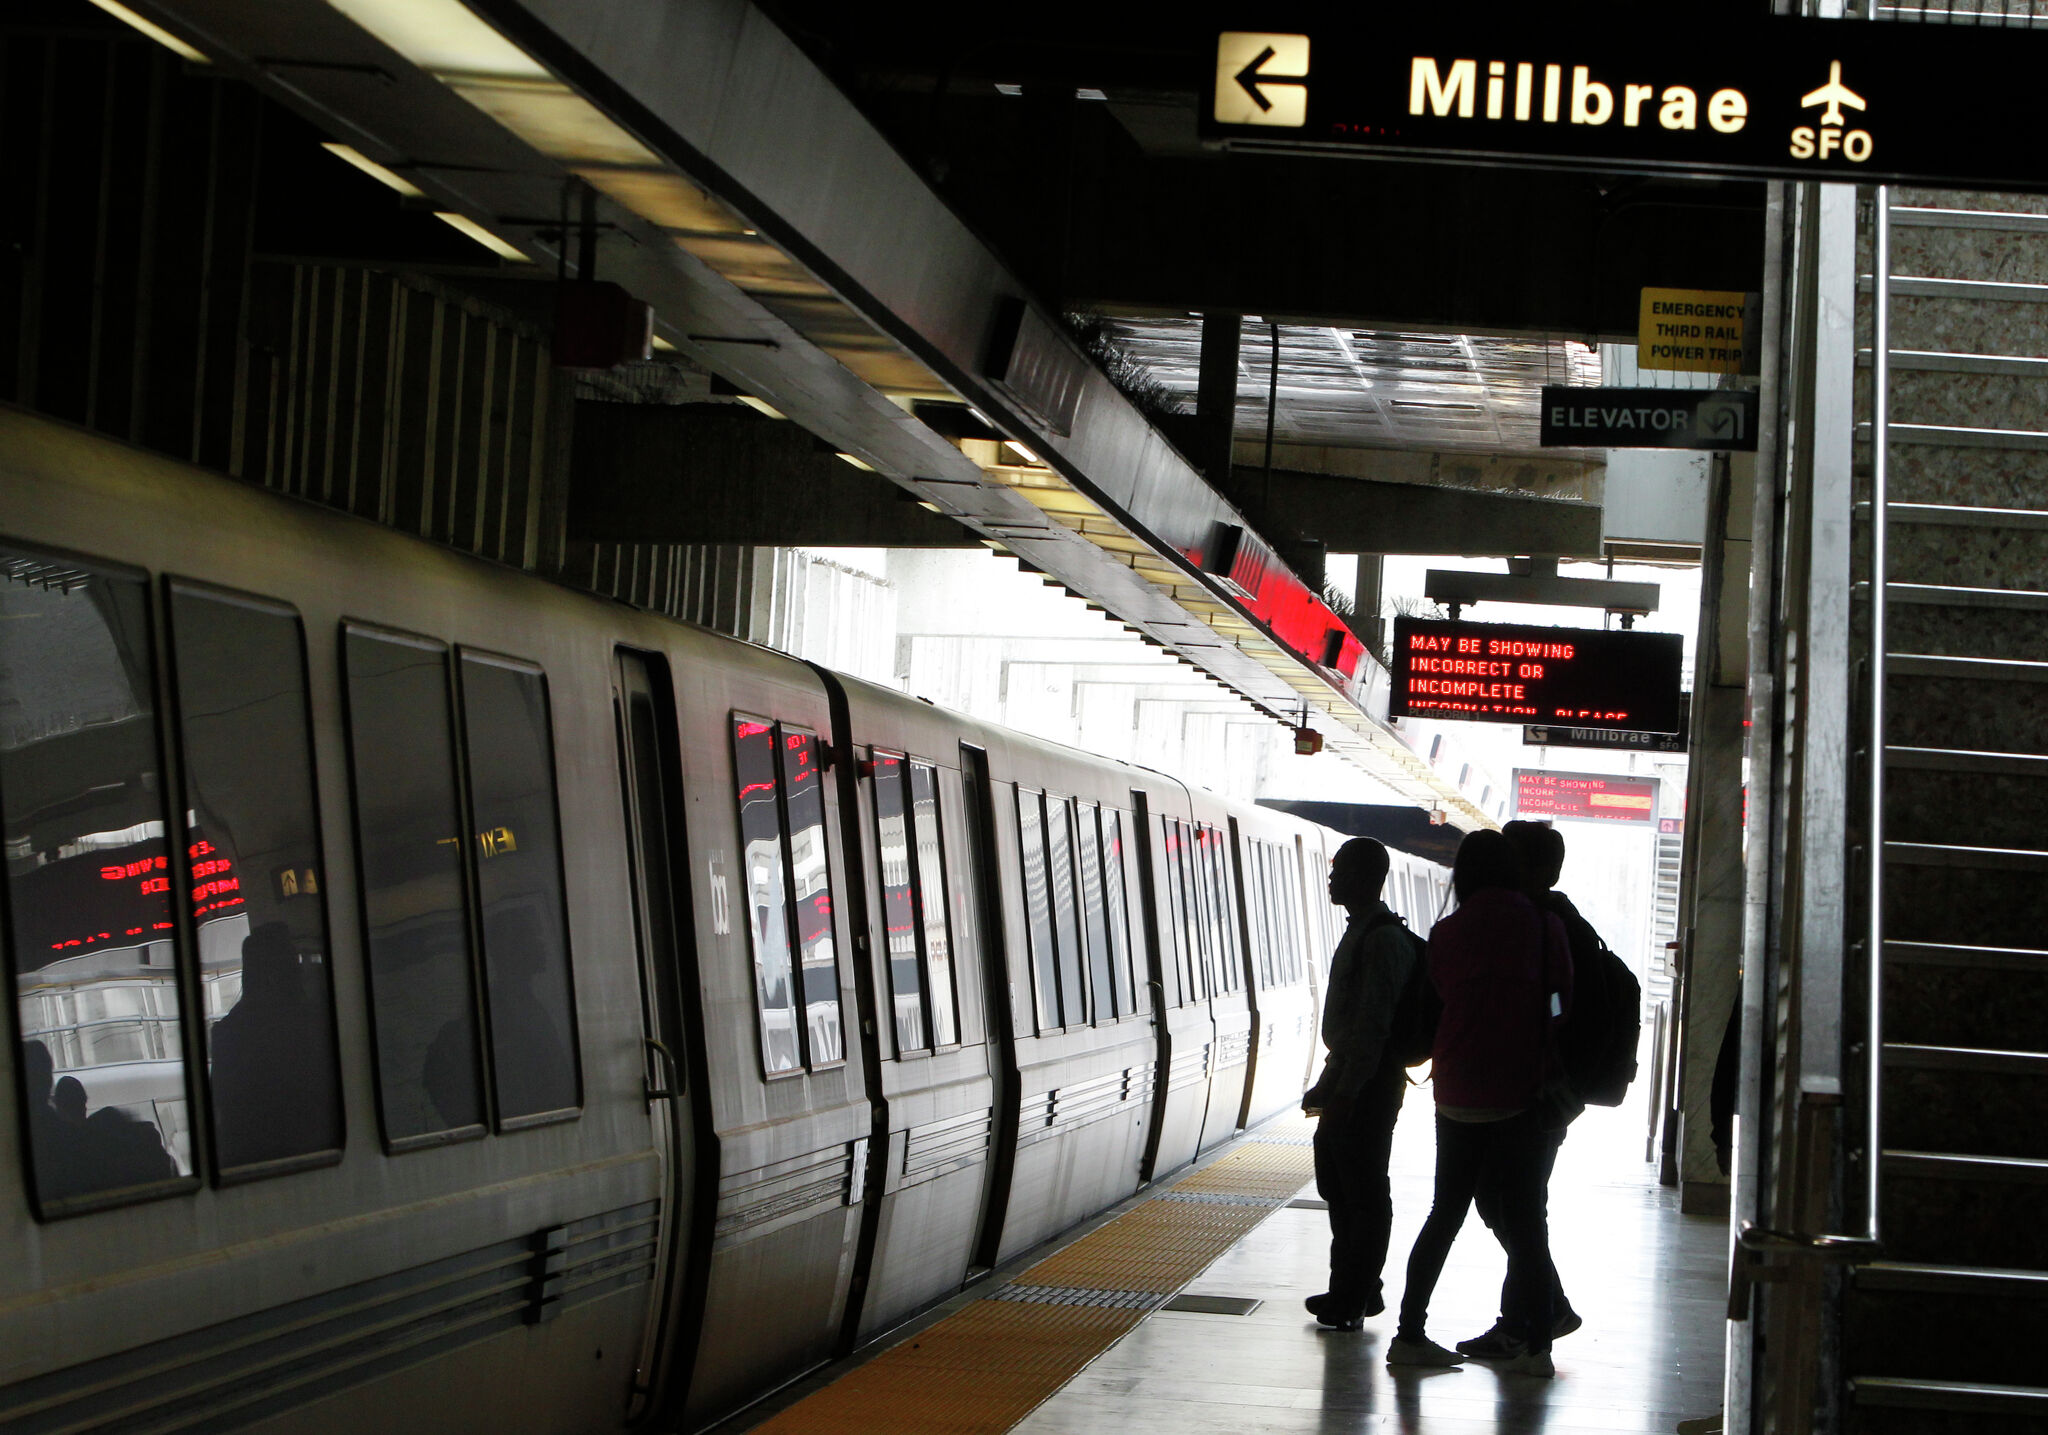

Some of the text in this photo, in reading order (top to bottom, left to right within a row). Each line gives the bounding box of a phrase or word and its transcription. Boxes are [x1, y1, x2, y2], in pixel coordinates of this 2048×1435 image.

[1408, 56, 1748, 134] Millbrae
[1789, 125, 1873, 163] SFO
[1652, 301, 1745, 319] EMERGENCY
[1656, 323, 1739, 340] THIRD RAIL
[1651, 344, 1743, 361] POWER TRIP
[1551, 406, 1689, 430] ELEVATOR
[1410, 635, 1575, 659] MAY BE SHOWING
[1410, 656, 1544, 679] INCORRECT OR
[1408, 678, 1526, 699] INCOMPLETE
[1571, 728, 1651, 744] Millbrae
[1519, 775, 1606, 790] MAY BE SHOWING
